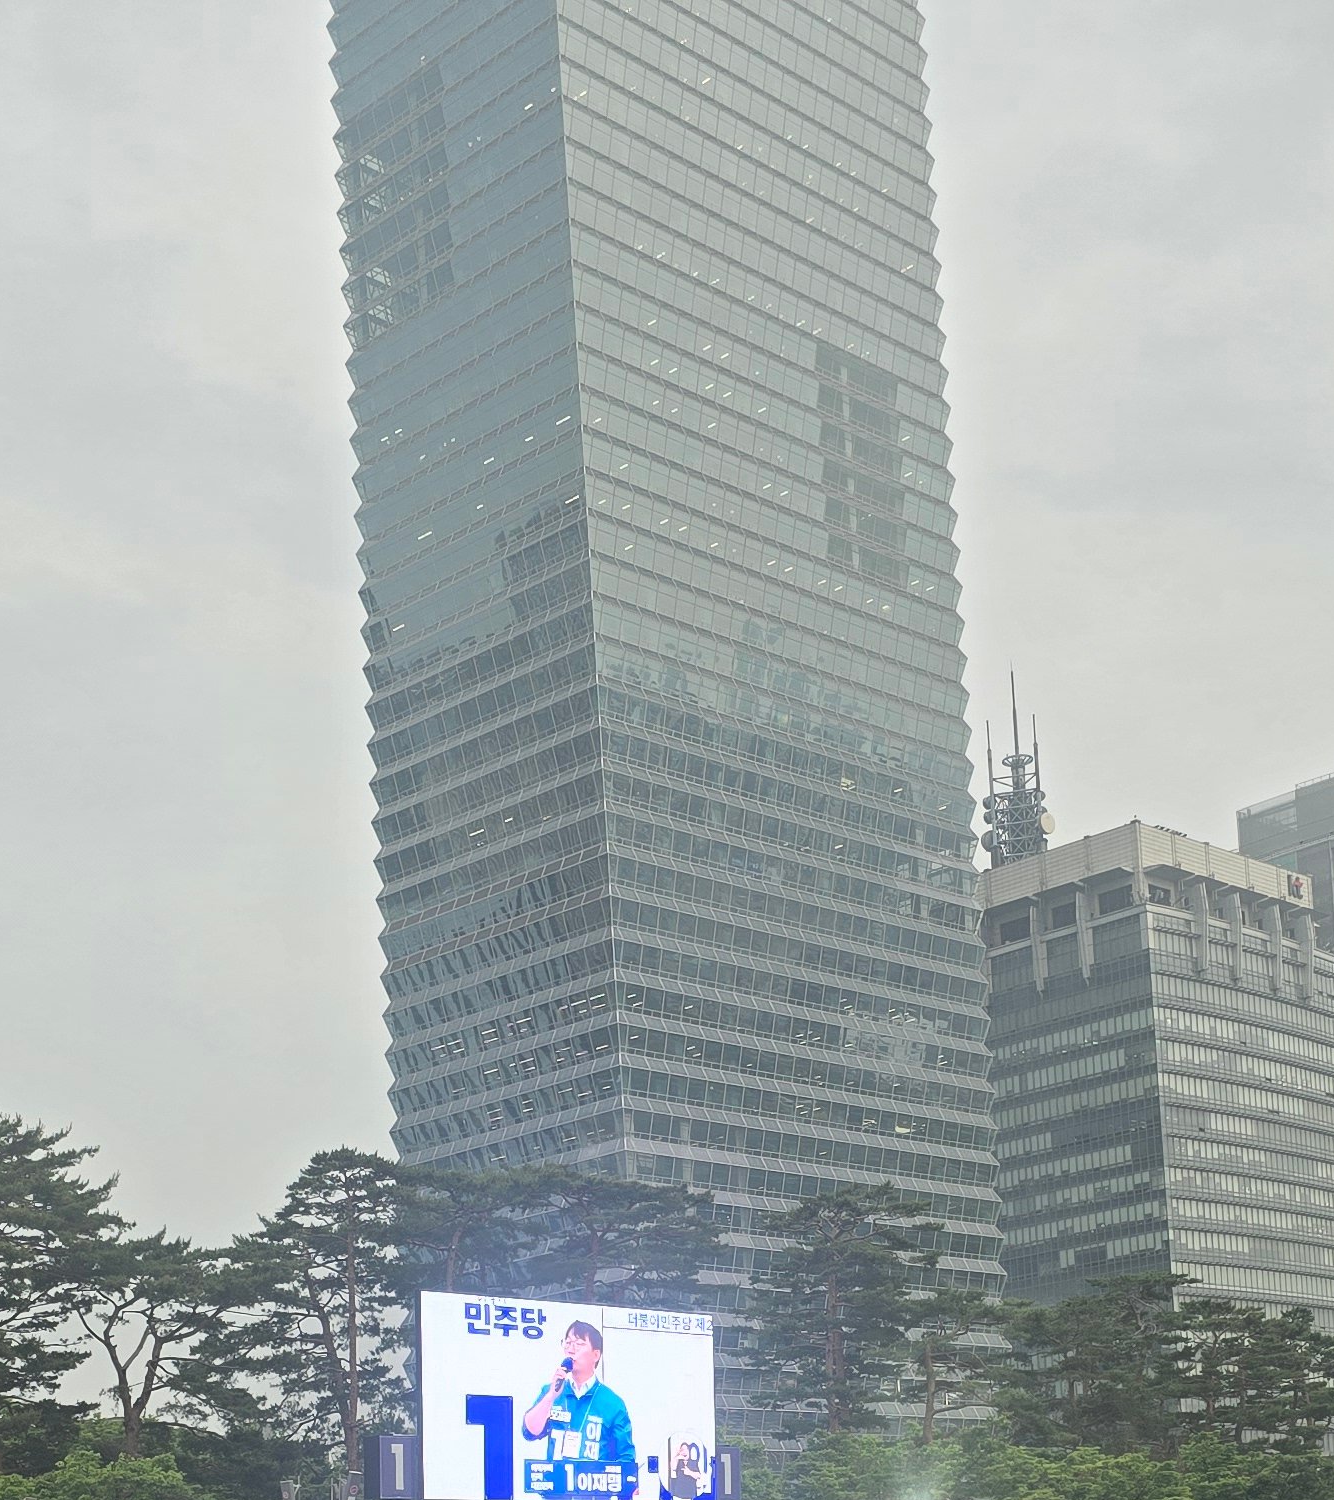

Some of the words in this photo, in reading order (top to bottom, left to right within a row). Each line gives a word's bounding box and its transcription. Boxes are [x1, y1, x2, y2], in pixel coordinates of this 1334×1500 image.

[464, 1302, 547, 1339] 민주당
[391, 1443, 405, 1490] 1
[466, 1394, 513, 1500] 1
[721, 1453, 731, 1495] 1
